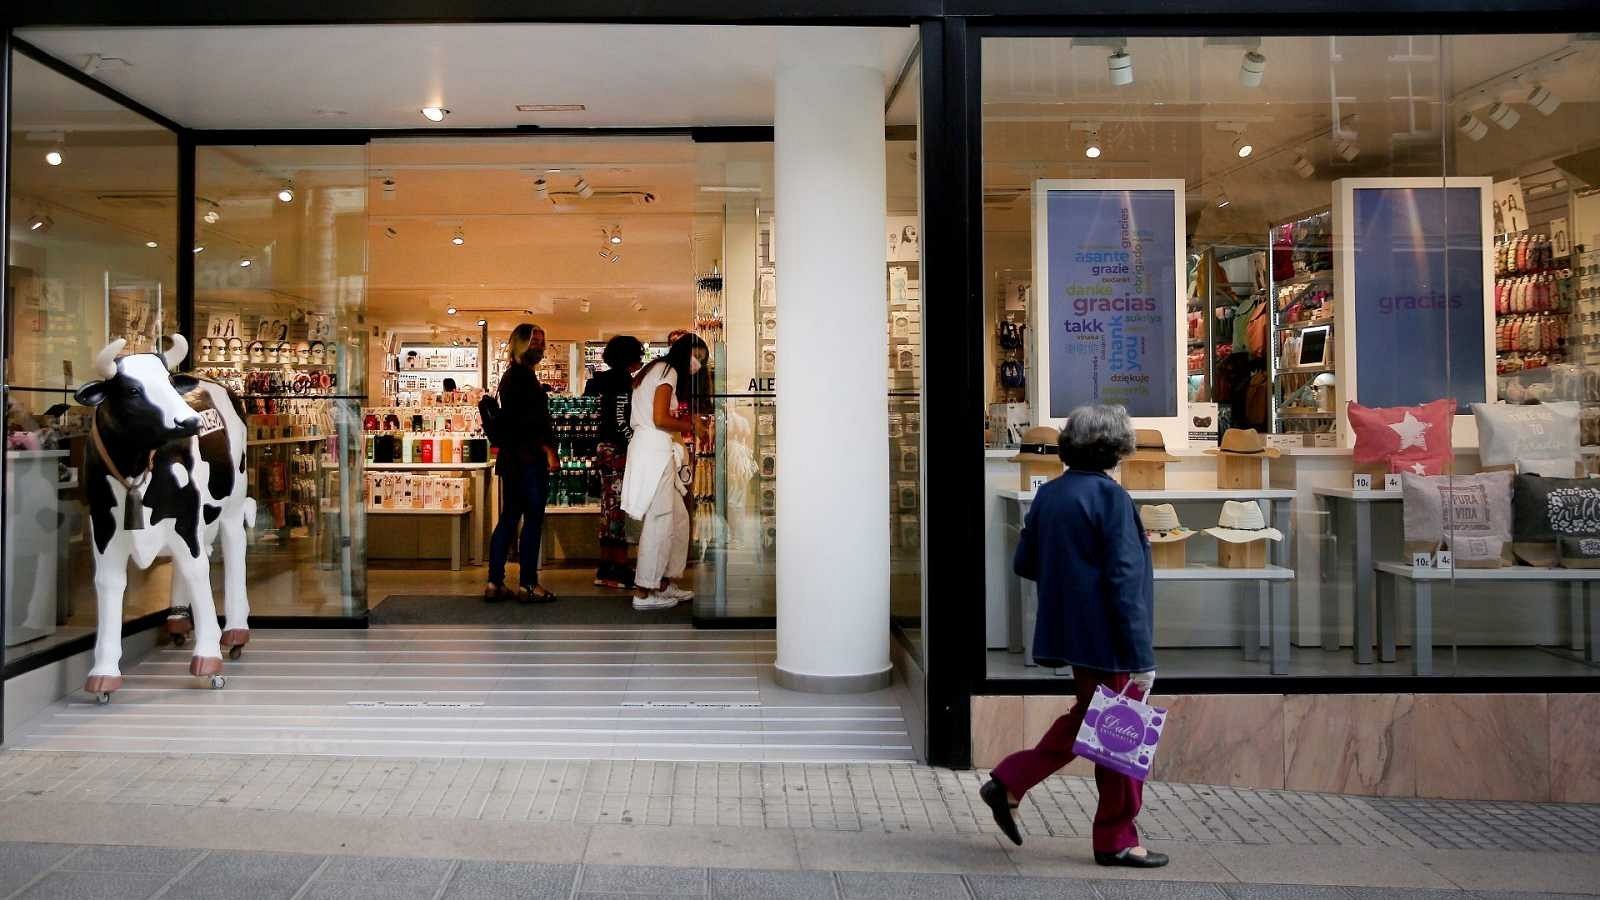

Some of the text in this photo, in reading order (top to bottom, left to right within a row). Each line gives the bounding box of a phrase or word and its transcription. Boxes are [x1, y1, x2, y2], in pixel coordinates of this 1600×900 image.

[1120, 208, 1132, 249] gracies
[1075, 250, 1129, 263] asante
[1091, 263, 1129, 277] grazie
[1065, 282, 1113, 295] danke
[1073, 292, 1156, 316] gracias
[1378, 290, 1463, 314] gracias
[1064, 318, 1104, 333] takk
[1108, 315, 1123, 371] thank
[1126, 336, 1141, 371] you
[616, 393, 629, 426] Thank
[1455, 507, 1478, 520] VIDA
